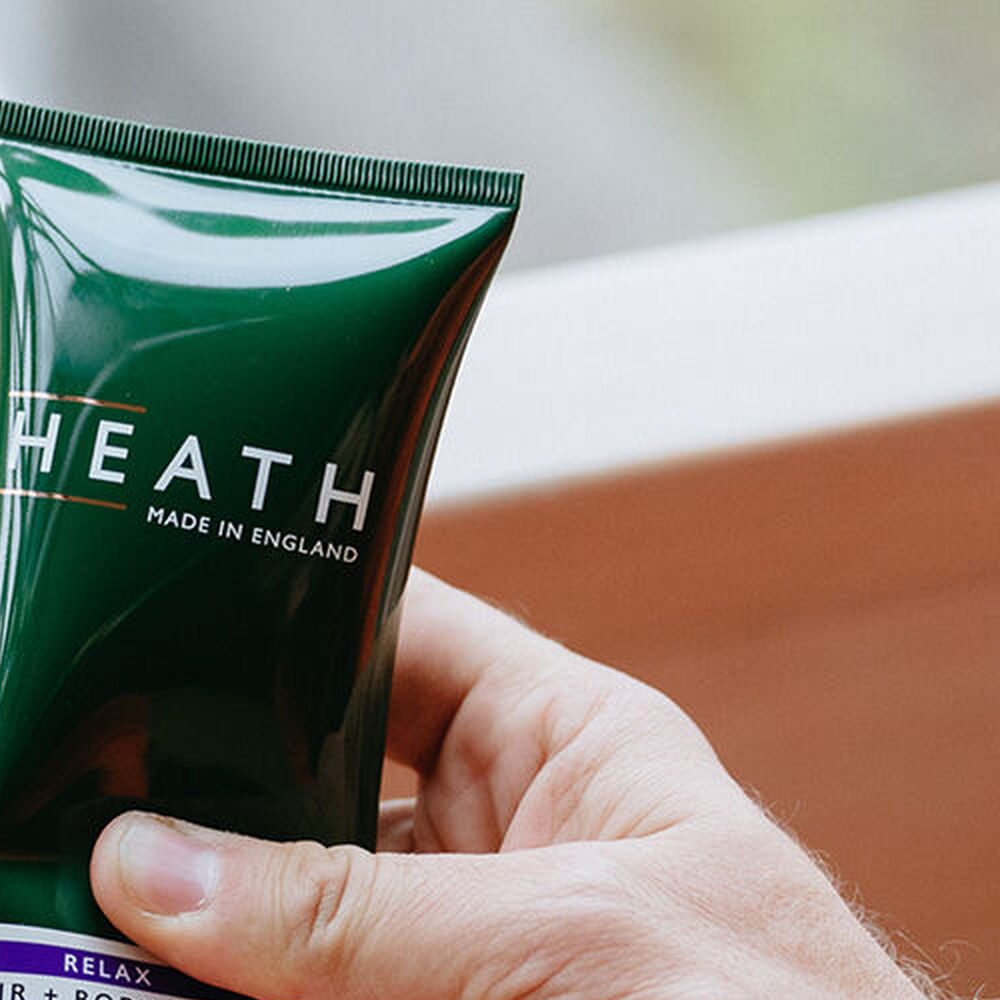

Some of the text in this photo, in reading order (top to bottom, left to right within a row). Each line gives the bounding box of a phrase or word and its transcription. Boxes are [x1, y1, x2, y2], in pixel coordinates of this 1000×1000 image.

[7, 411, 376, 531] HEATH
[147, 506, 359, 564] MADE IN ENGLAND
[64, 954, 151, 986] RELAX
